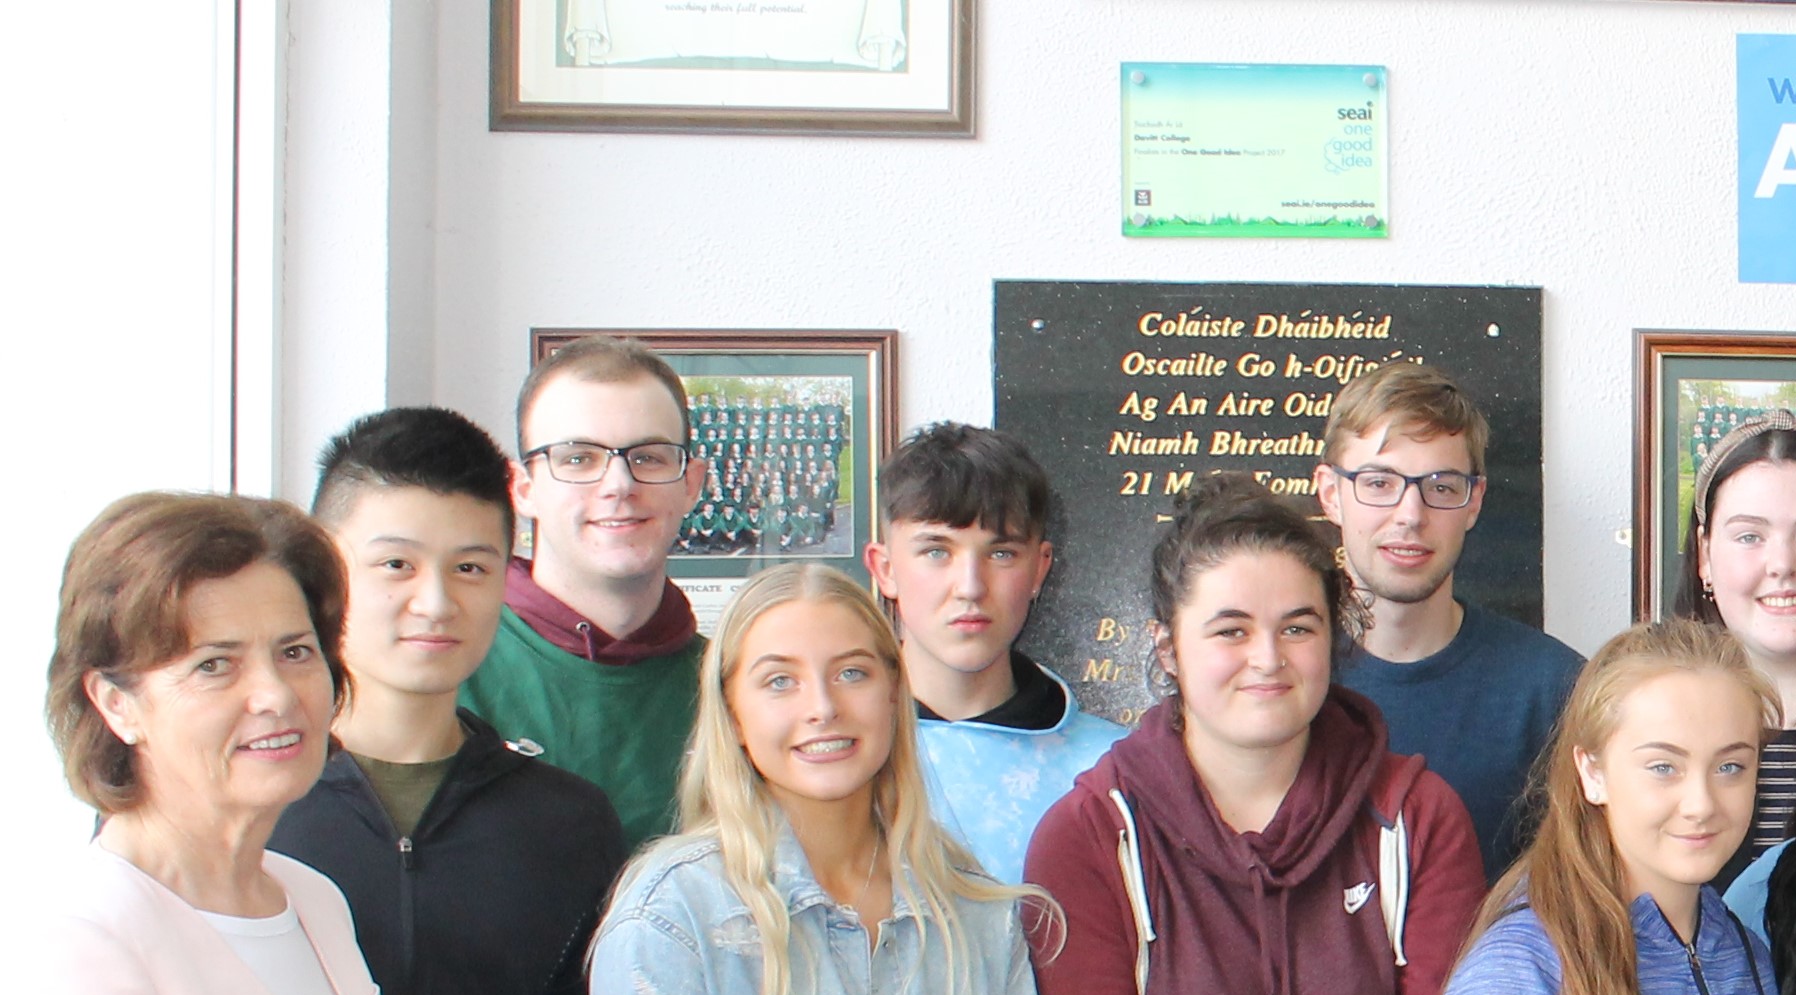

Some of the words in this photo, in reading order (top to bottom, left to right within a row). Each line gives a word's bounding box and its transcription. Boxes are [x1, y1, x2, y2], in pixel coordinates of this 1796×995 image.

[1337, 101, 1374, 121] seai
[1343, 125, 1373, 136] one
[1332, 137, 1373, 155] good
[1341, 154, 1373, 168] idea
[1138, 306, 1246, 338] Coláiste
[1254, 309, 1392, 339] Dháibhéid
[1121, 350, 1229, 377] Oscailte
[1236, 352, 1276, 378] Go
[1119, 391, 1160, 422] Ag
[1167, 391, 1209, 416] An
[1216, 392, 1275, 417] Aire
[1109, 431, 1200, 456] Niamh
[1120, 471, 1154, 496] 21
[1096, 616, 1132, 646] By
